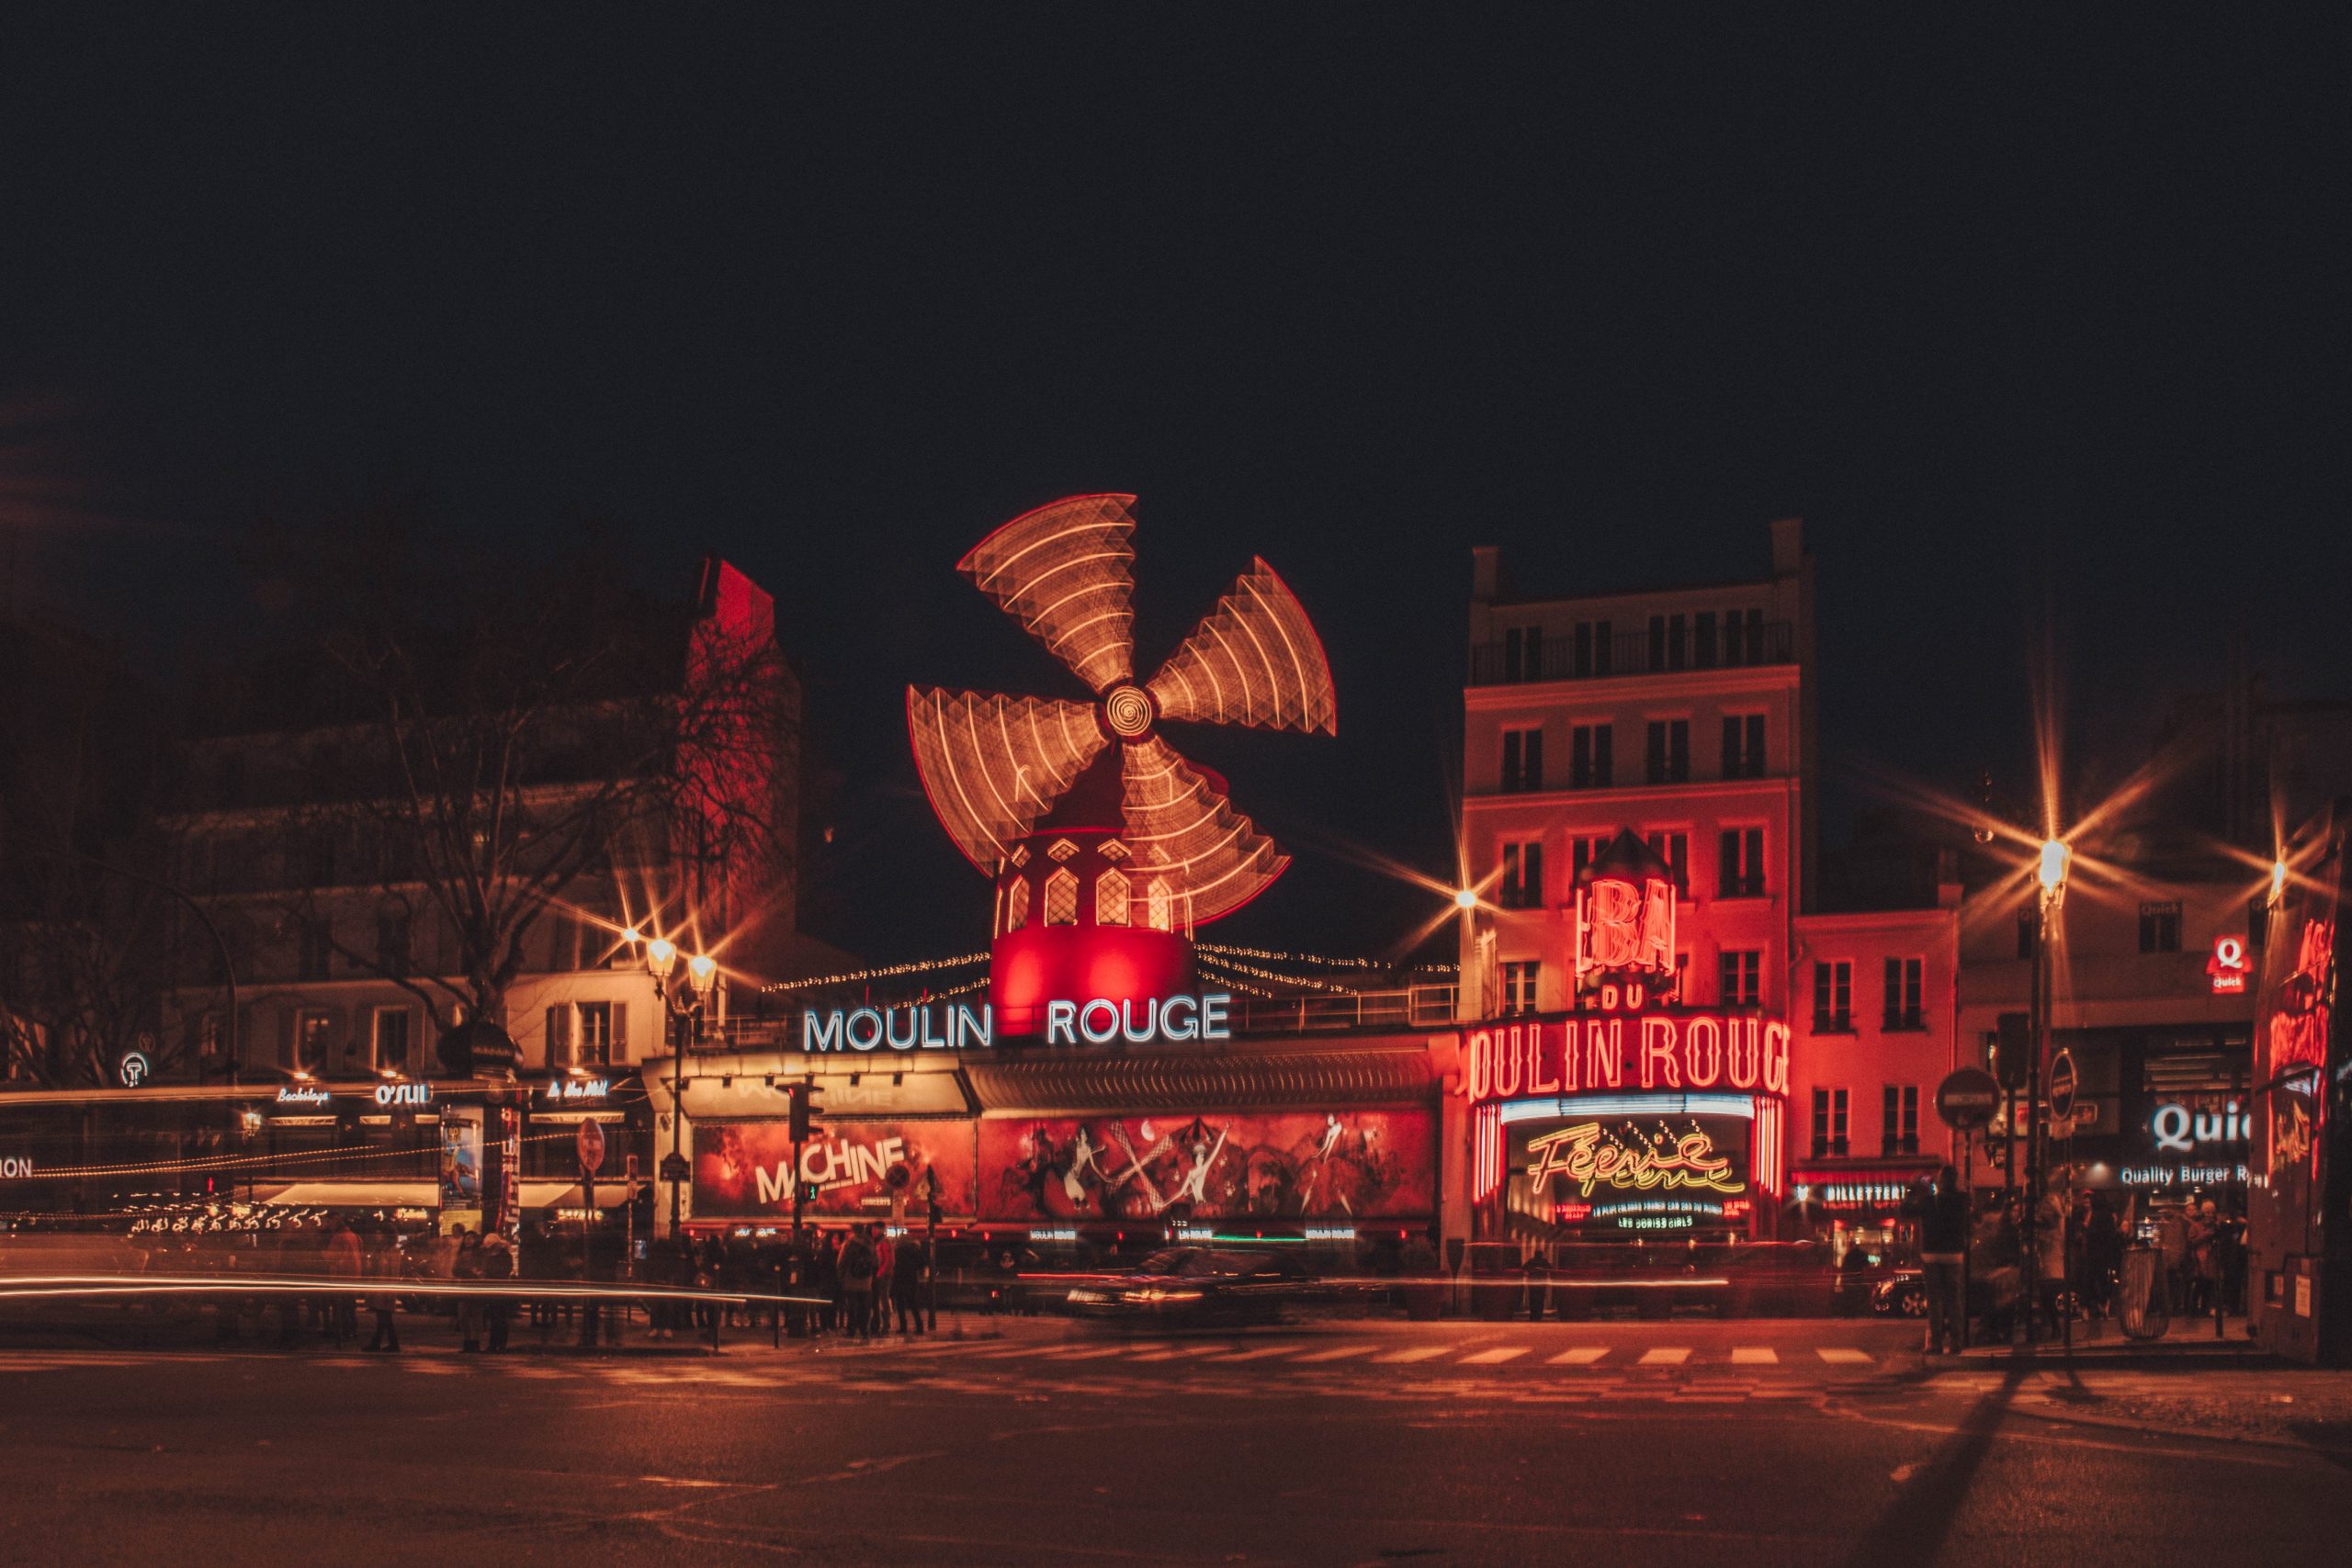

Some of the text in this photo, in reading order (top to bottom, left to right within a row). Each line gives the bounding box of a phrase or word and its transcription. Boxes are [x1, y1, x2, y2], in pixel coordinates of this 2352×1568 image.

[2217, 938, 2244, 969] Q
[2212, 976, 2241, 989] Quick
[1602, 984, 1644, 1010] DU
[802, 994, 1231, 1052] MOULIN ROUGE
[1470, 1016, 1791, 1103] OULIN ROUG
[277, 1087, 330, 1106] Backstage
[2120, 1167, 2174, 1186] Quality
[2181, 1164, 2229, 1184] Burger
[860, 1197, 891, 1206] CONCERTS
[1618, 1217, 1634, 1228] LES
[1668, 1214, 1692, 1228] GIRLS
